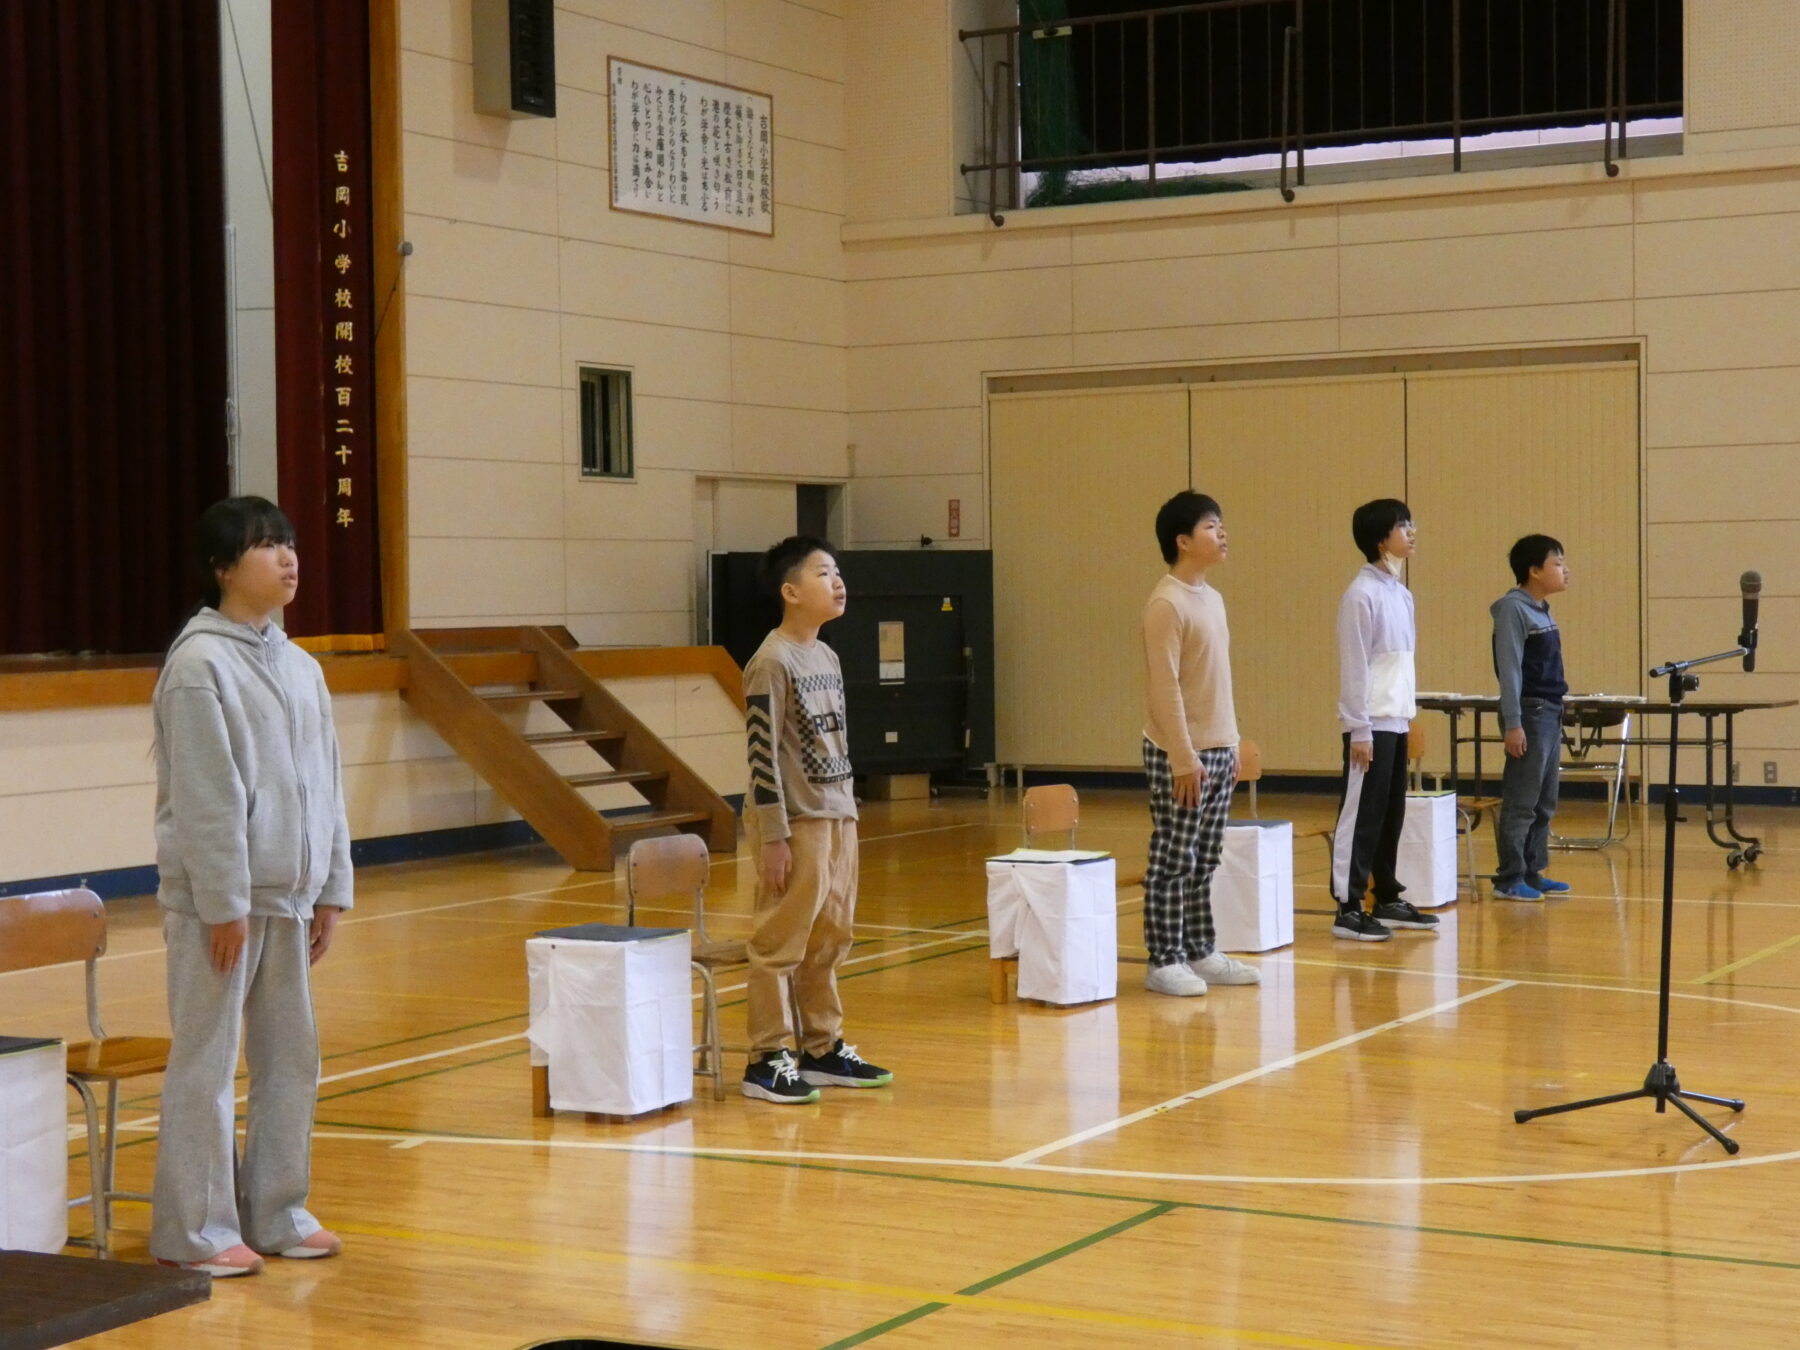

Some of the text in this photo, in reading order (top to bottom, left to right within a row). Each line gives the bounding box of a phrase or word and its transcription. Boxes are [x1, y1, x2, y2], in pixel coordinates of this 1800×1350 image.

[333, 149, 354, 528] 吉岡小学校開校百二十周年
